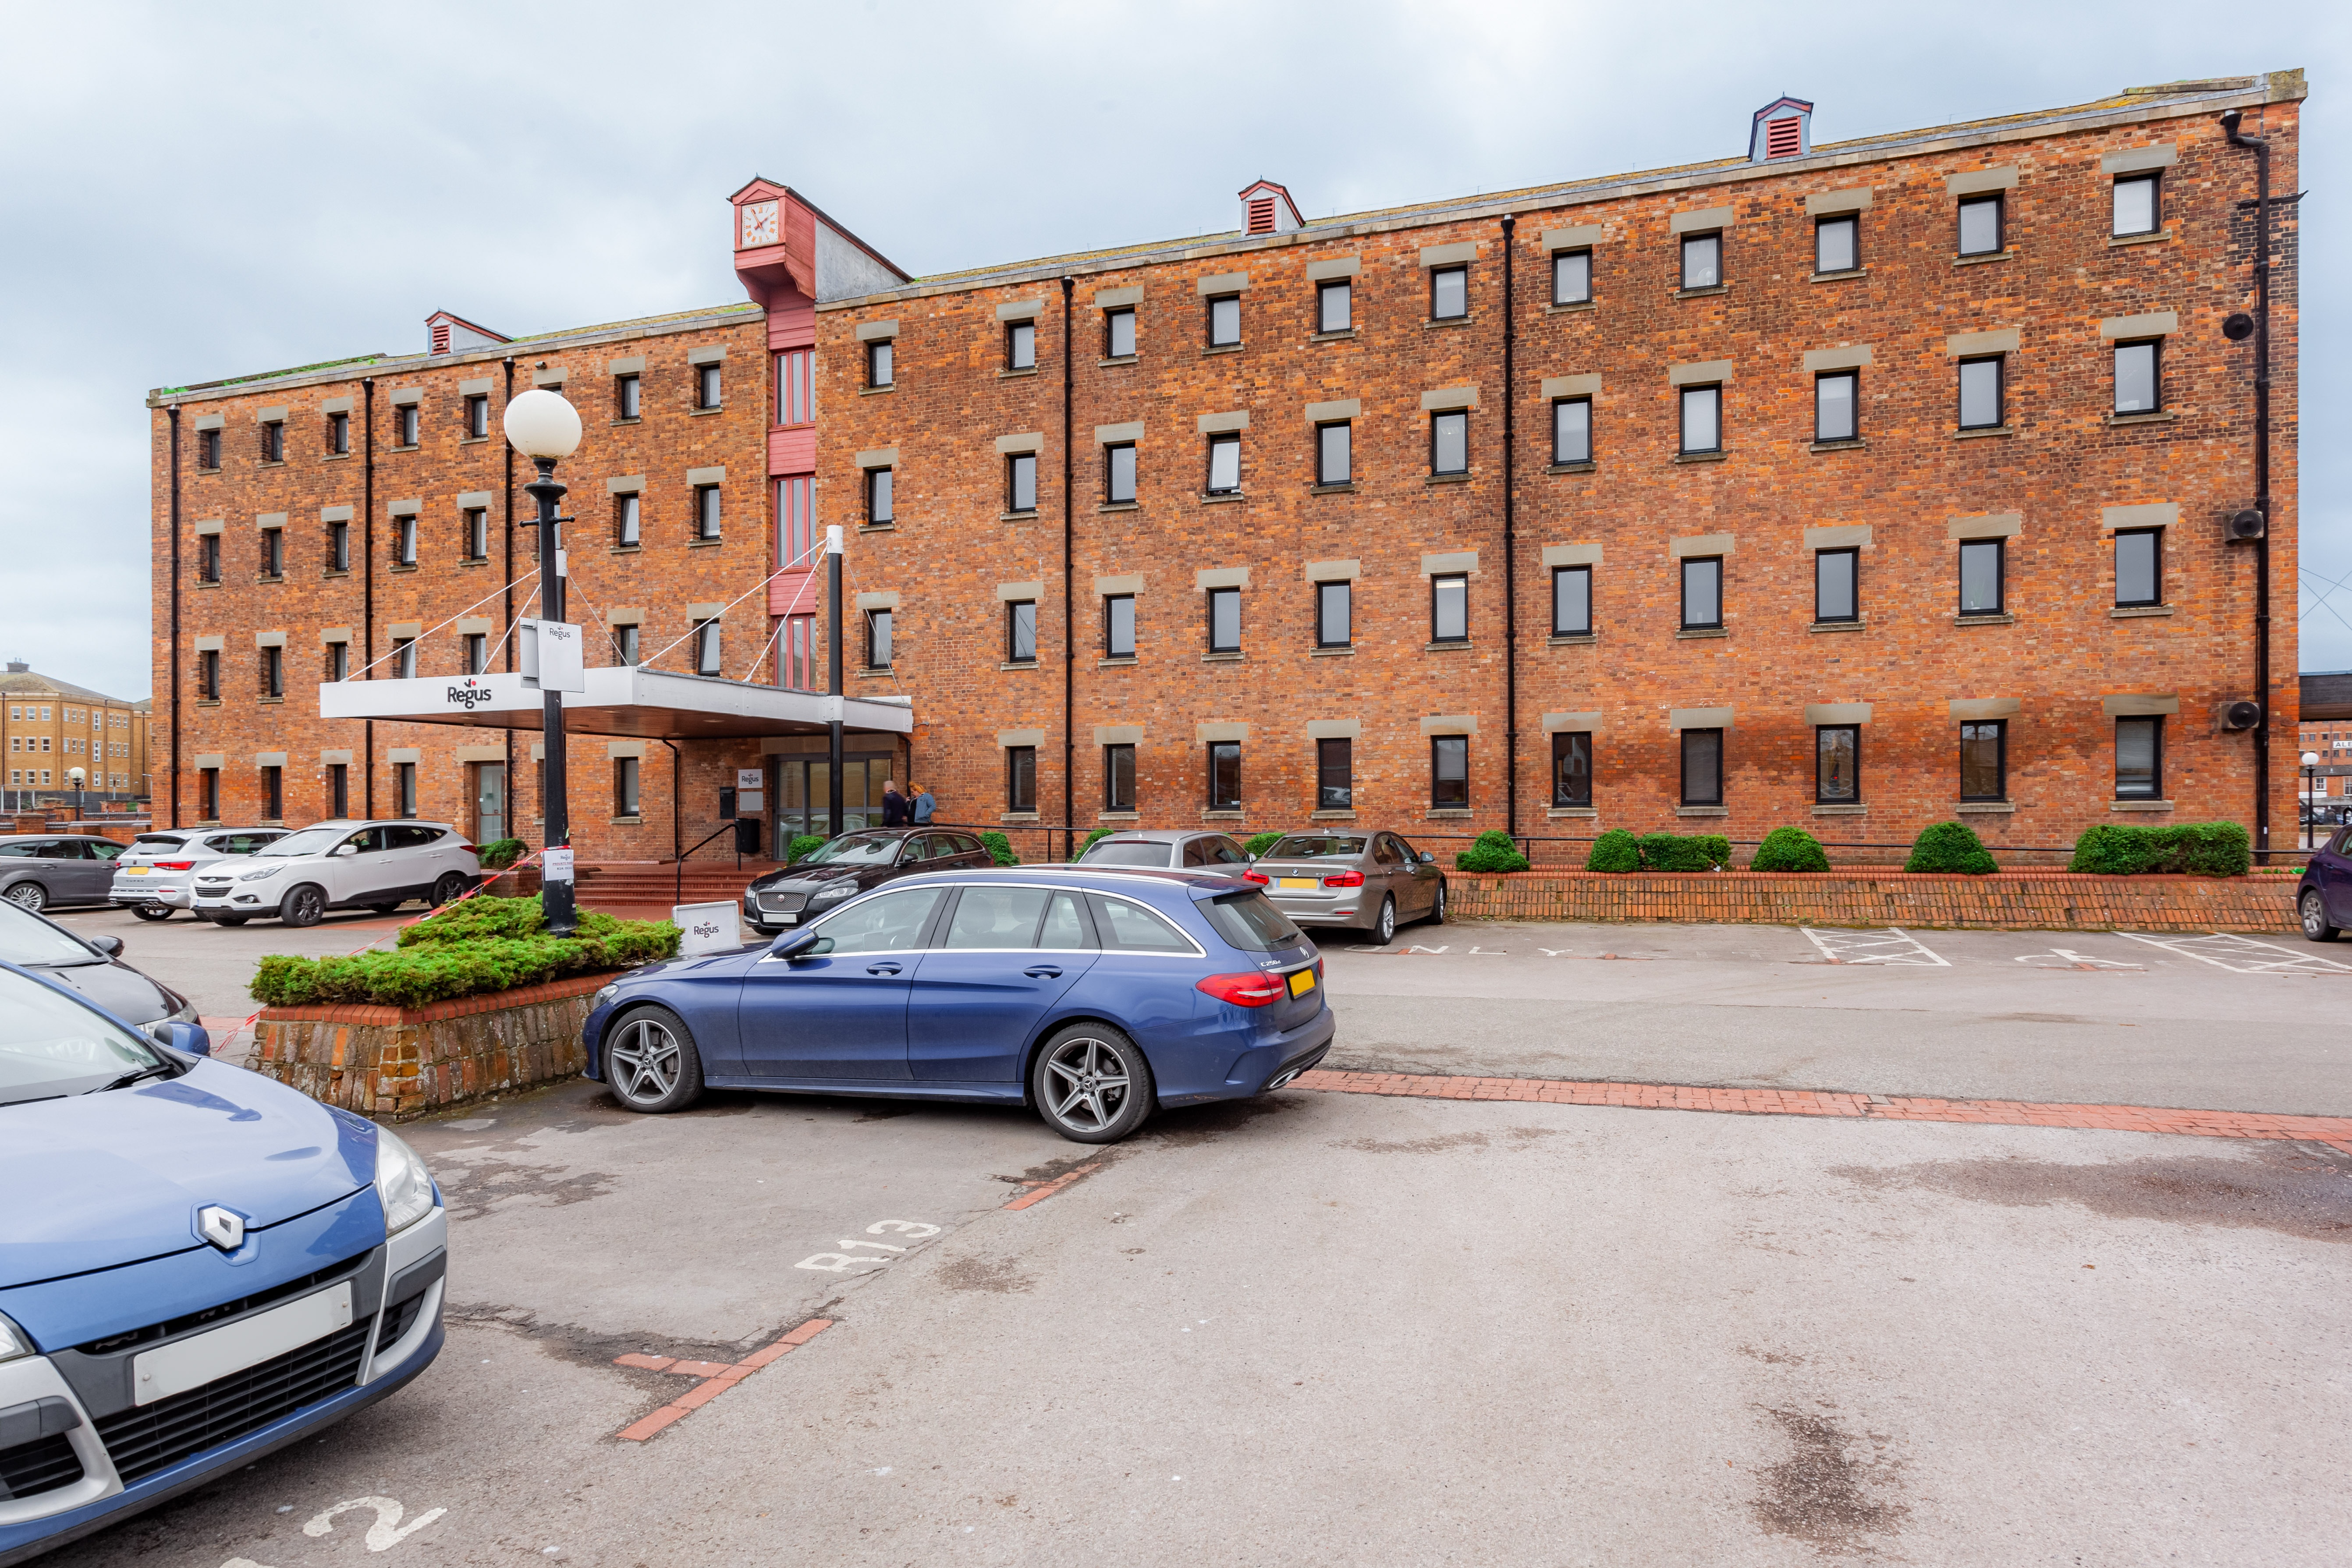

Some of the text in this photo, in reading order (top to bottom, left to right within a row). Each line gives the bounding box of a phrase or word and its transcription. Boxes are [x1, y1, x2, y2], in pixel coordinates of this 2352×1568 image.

[550, 628, 571, 640] Regus
[447, 686, 491, 709] Regus
[741, 776, 759, 784] Regus
[694, 926, 719, 938] Regus
